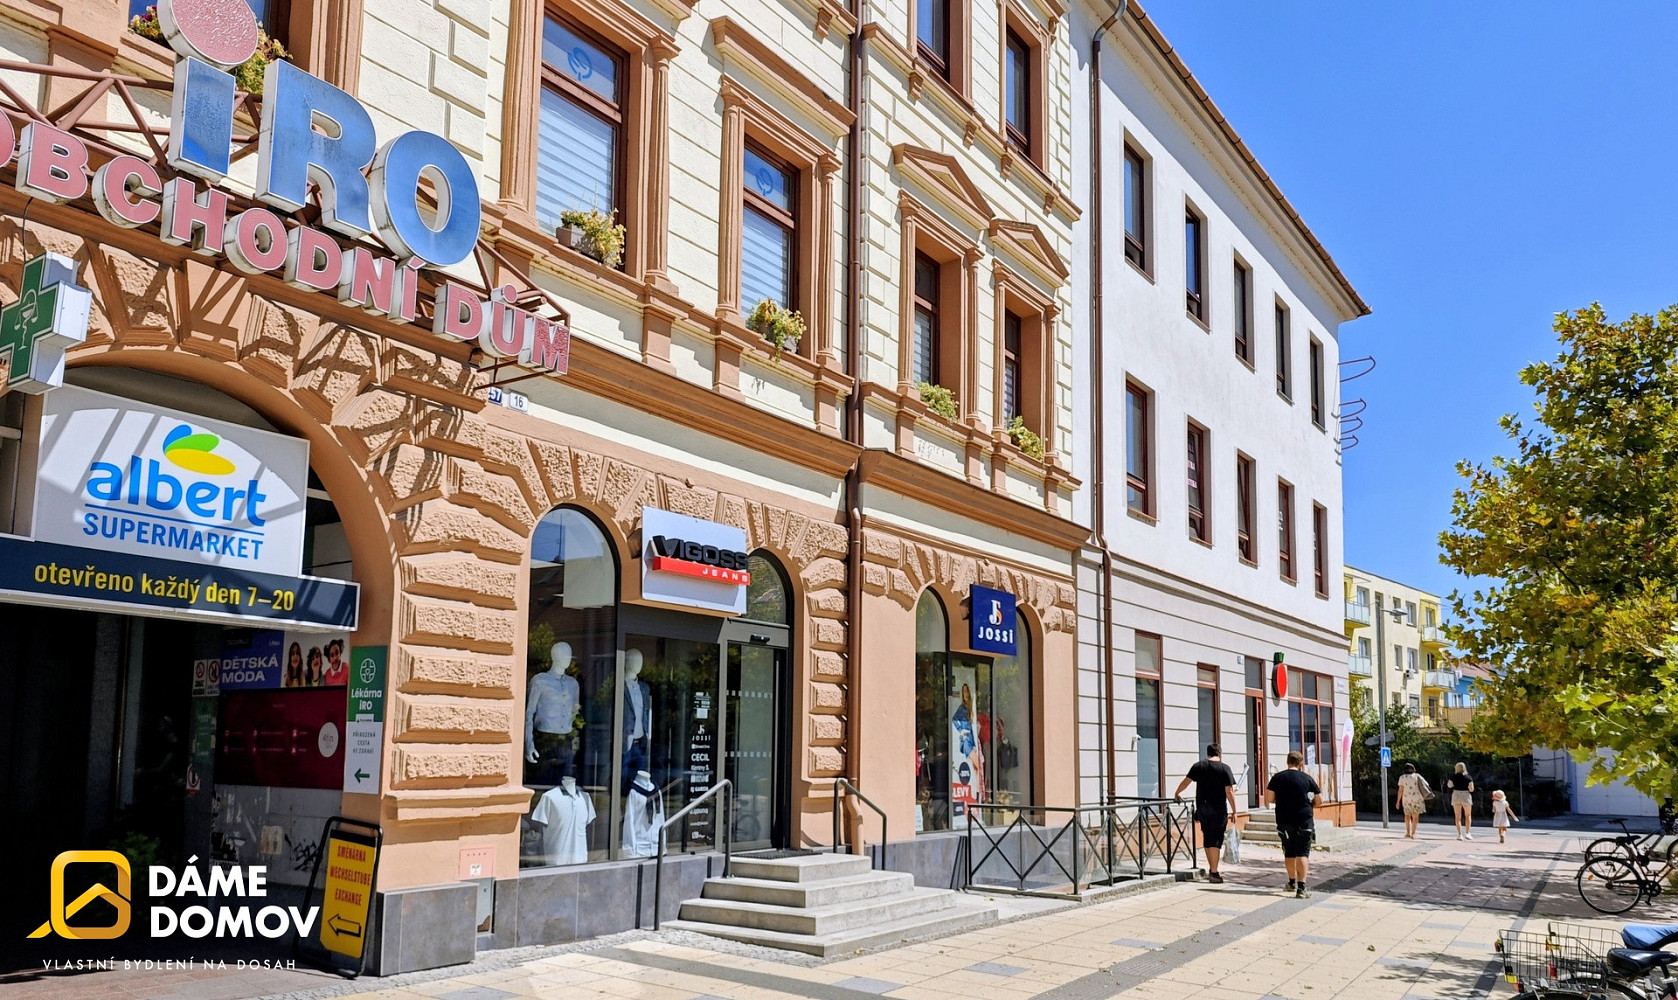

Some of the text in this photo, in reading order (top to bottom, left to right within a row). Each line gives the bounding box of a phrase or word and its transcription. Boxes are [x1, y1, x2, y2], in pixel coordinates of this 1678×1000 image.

[0, 106, 572, 376] BCHODNÍ DŮM
[514, 394, 525, 409] 16
[86, 454, 268, 527] albert
[82, 512, 265, 560] SUPERMARKET
[651, 534, 749, 571] VIGOSS
[33, 561, 135, 593] otevřeno
[140, 576, 202, 604] každý
[205, 583, 242, 607] den
[701, 567, 749, 583] JEANS
[222, 653, 279, 670] DĚTSKÁ
[221, 669, 266, 683] MÓDA
[351, 687, 383, 699] Lékárna
[690, 753, 710, 762] CECIL
[337, 844, 367, 862] SMĚNÁRNA
[329, 865, 371, 887] WECHSELSTUBE
[335, 887, 363, 907] EXCHANGE
